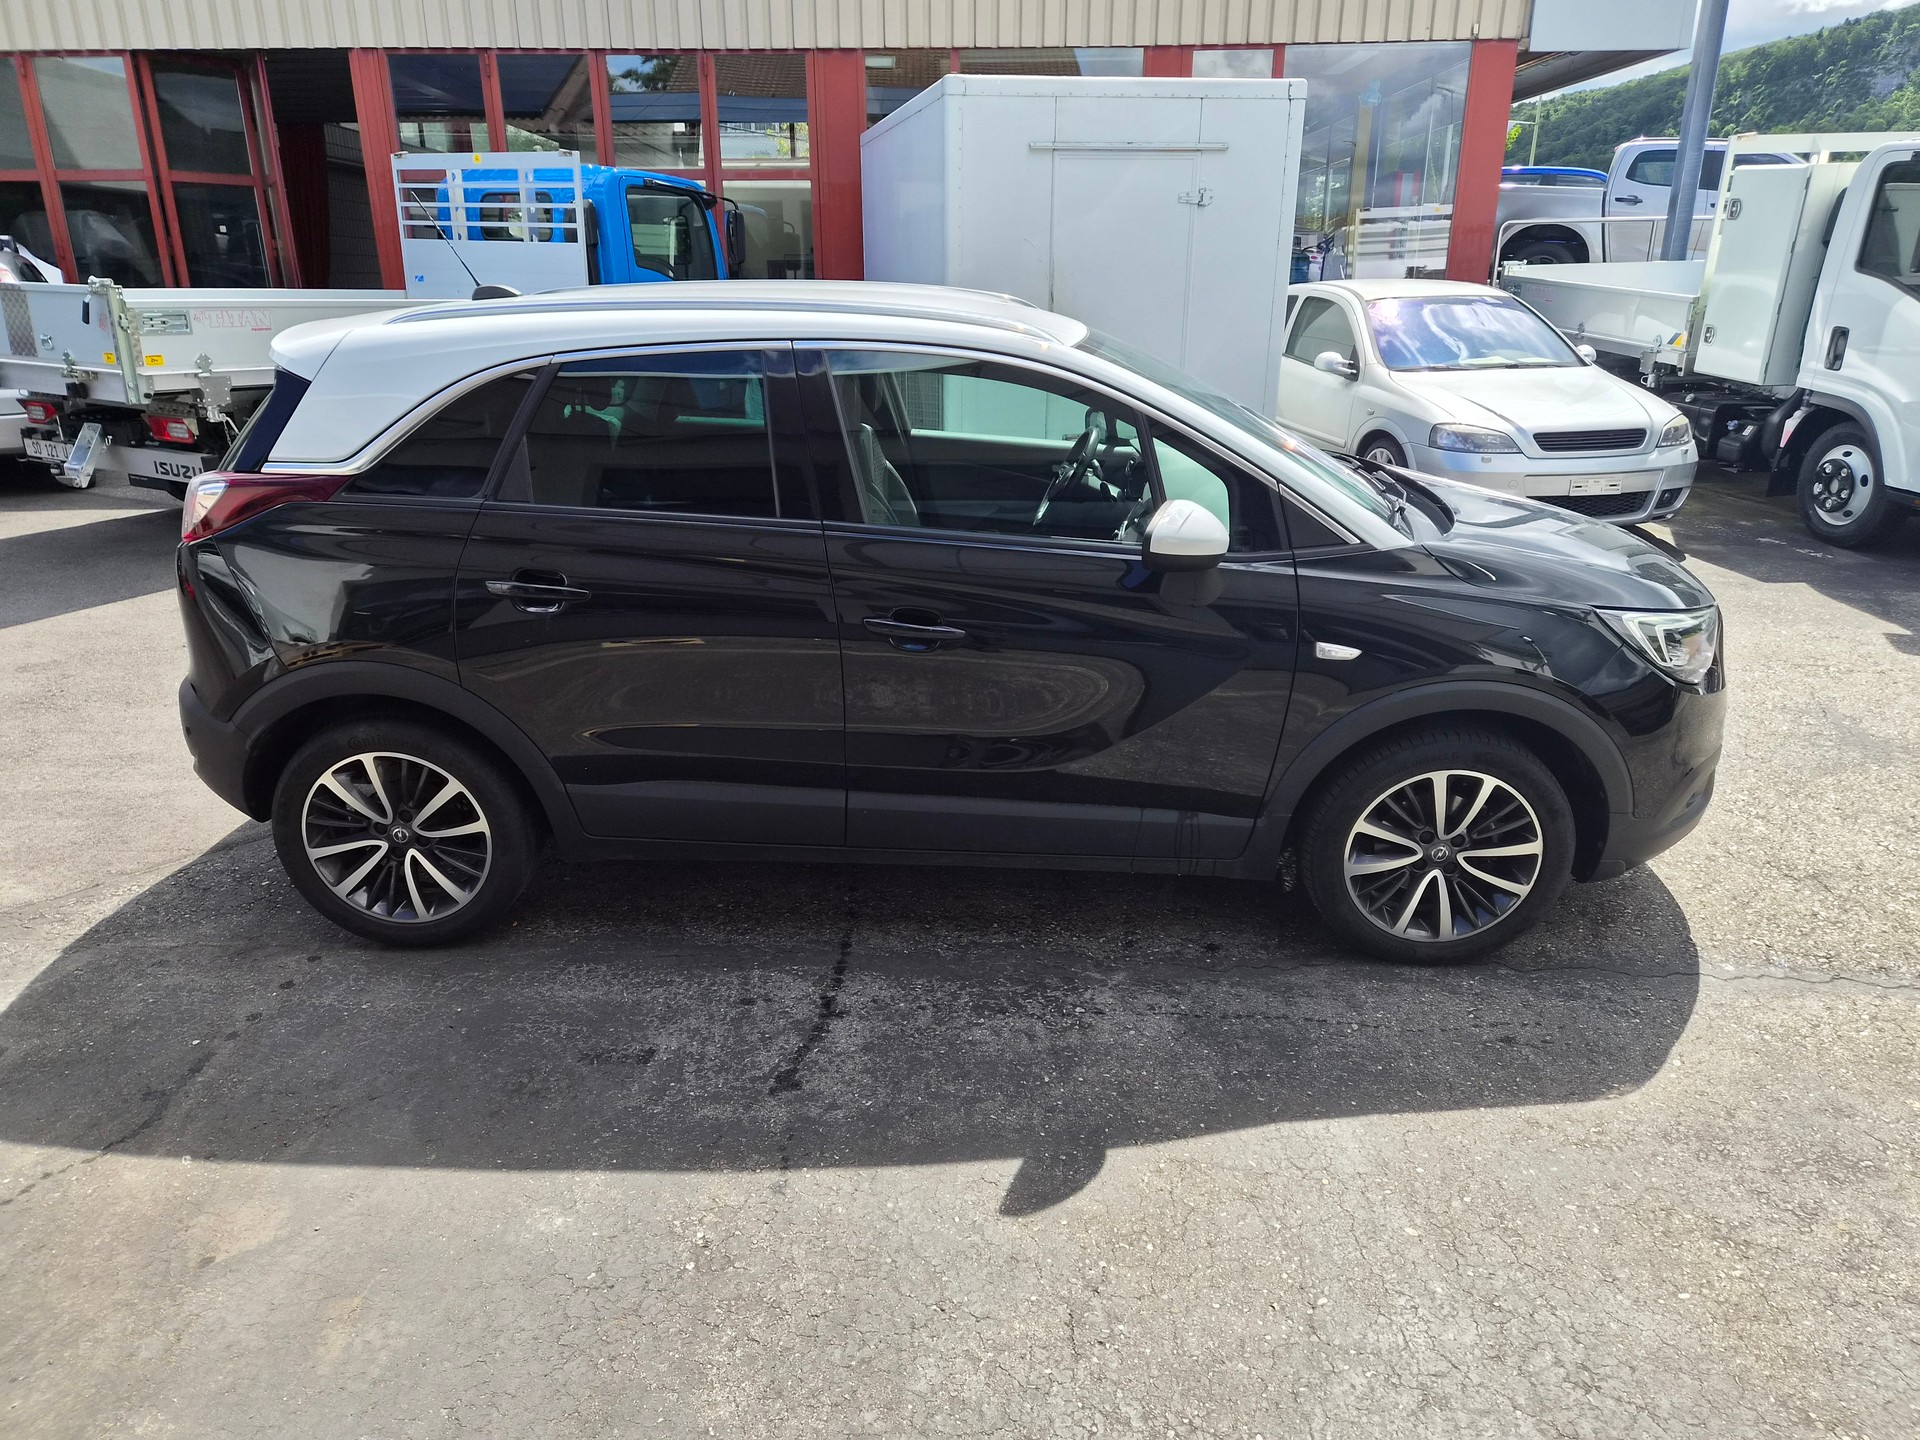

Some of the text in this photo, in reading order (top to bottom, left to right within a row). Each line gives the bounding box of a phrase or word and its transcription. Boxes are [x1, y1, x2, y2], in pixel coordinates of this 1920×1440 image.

[203, 309, 272, 328] TITAN
[44, 444, 59, 458] 121
[62, 446, 69, 459] U
